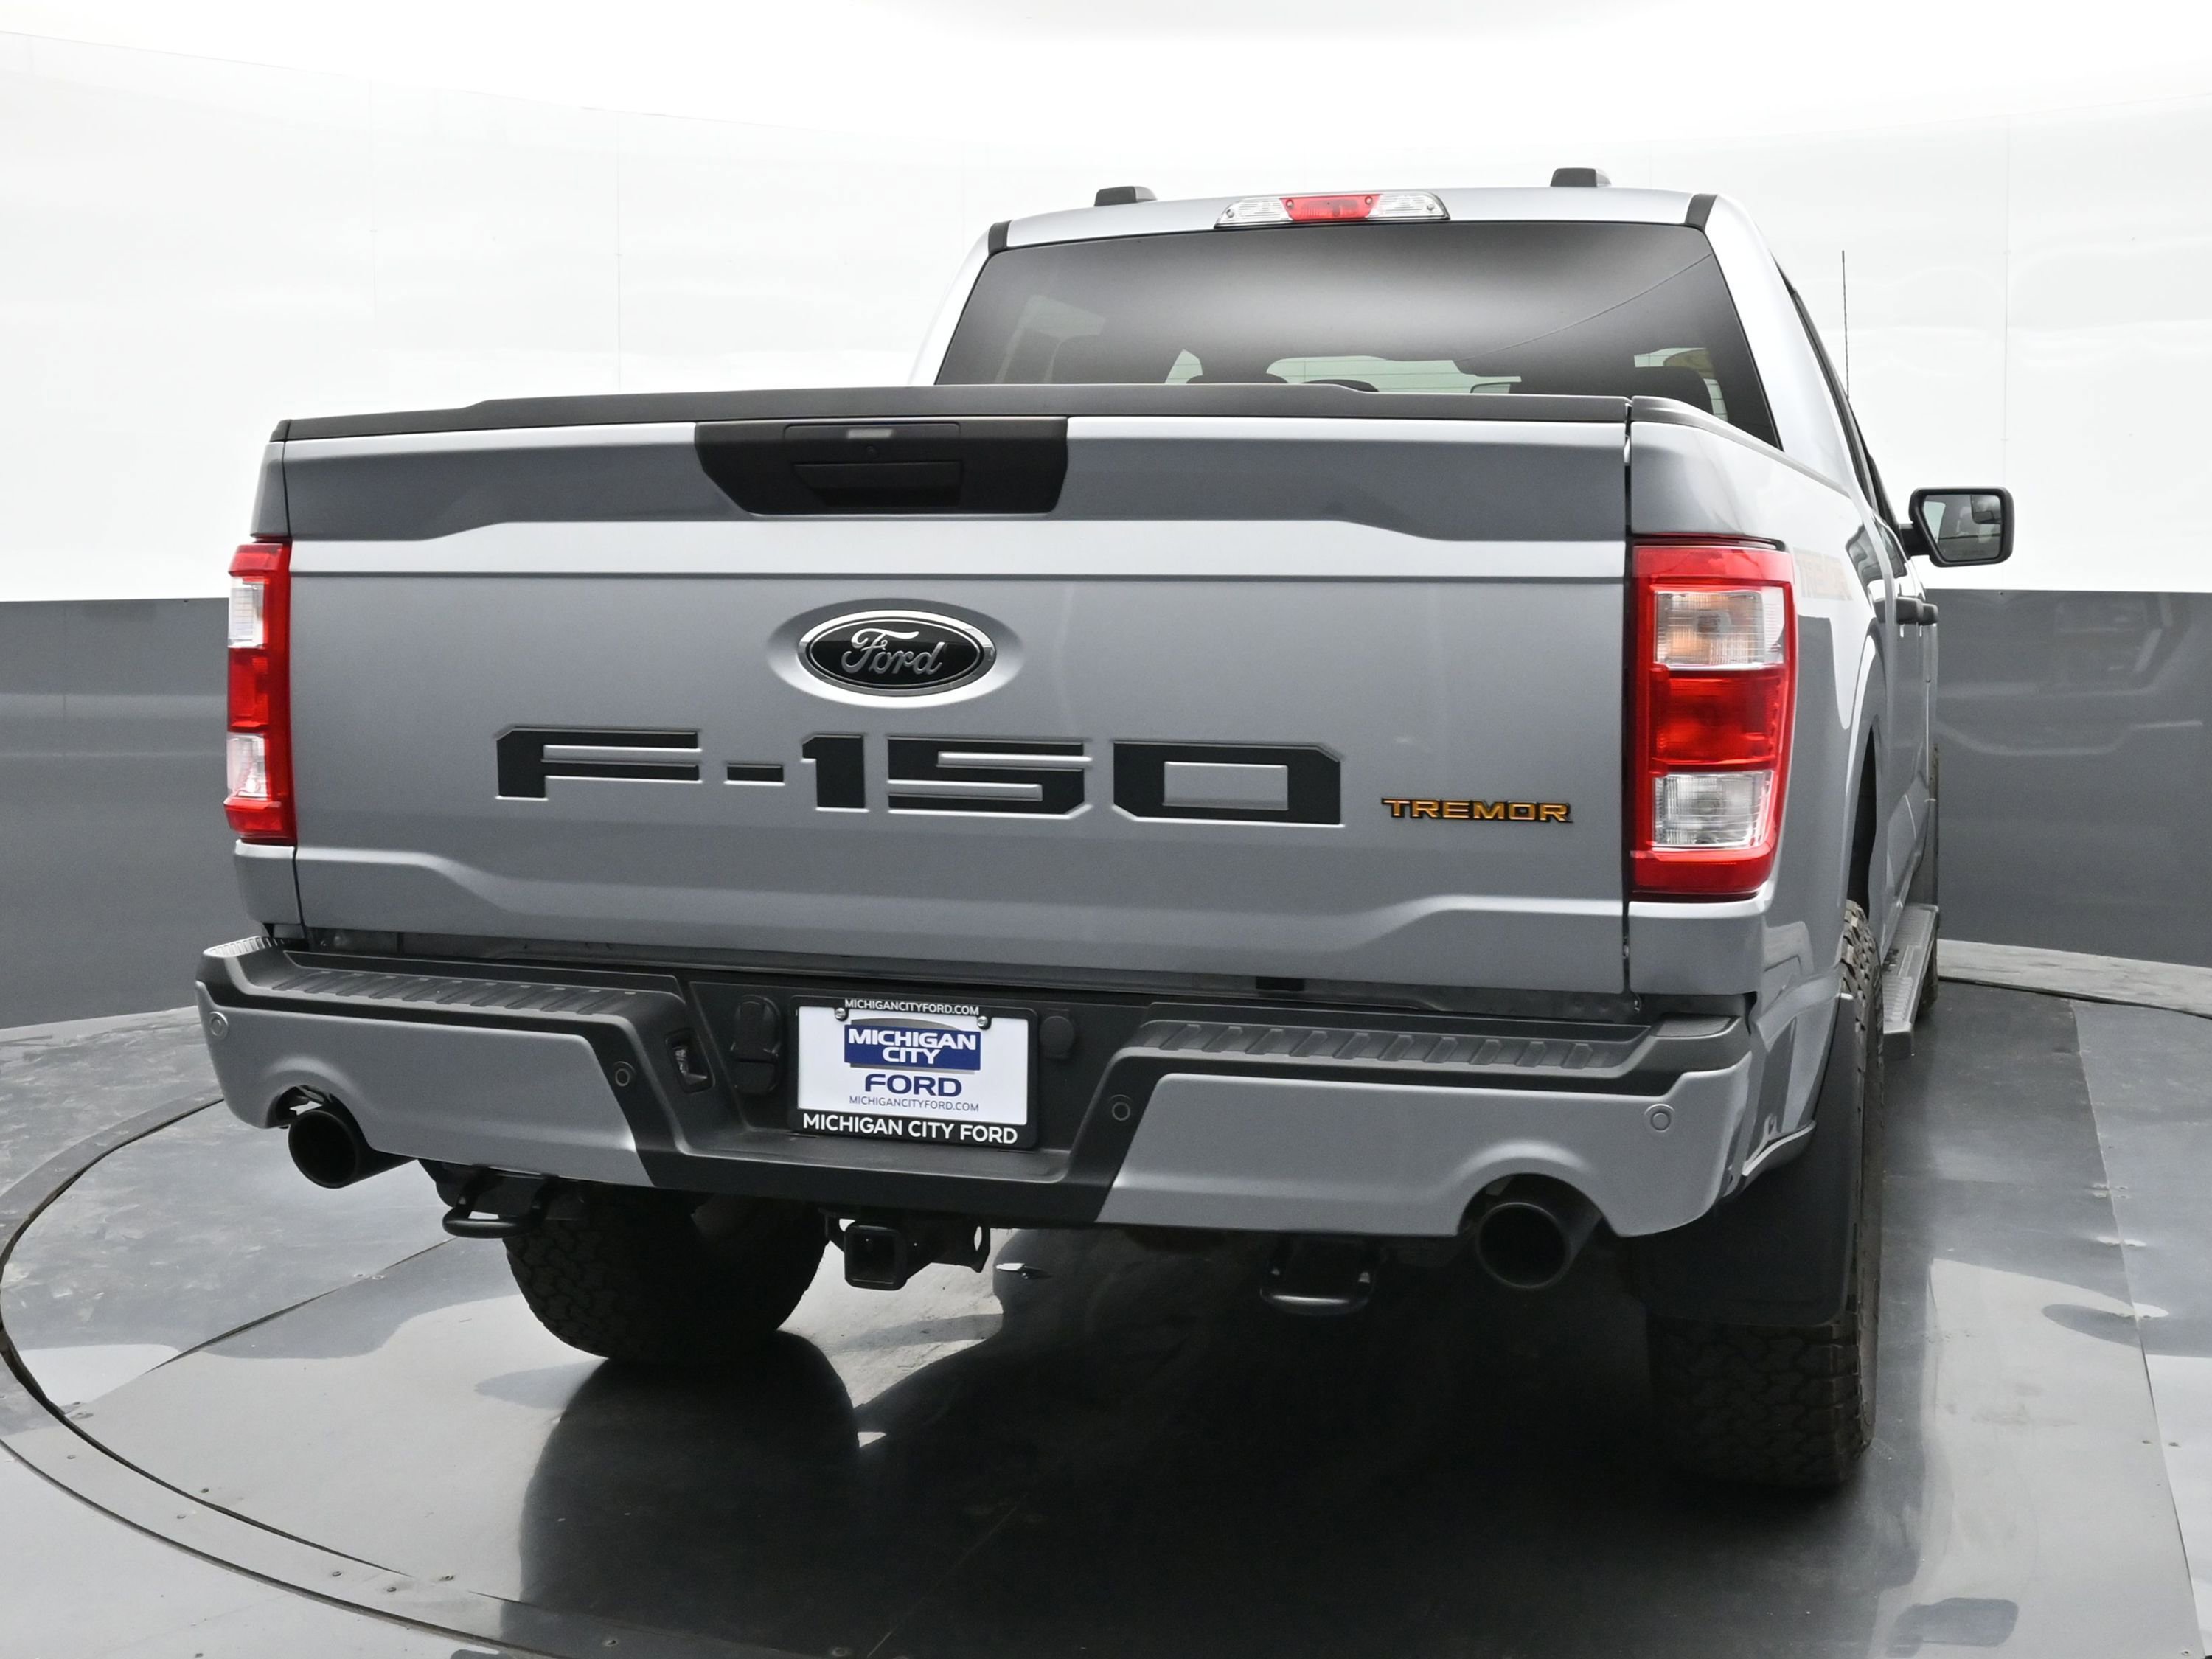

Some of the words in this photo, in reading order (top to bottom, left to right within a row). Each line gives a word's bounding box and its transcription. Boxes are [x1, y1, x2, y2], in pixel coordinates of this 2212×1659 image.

[841, 627, 945, 675] Ford
[495, 726, 1345, 827] F-150
[1381, 798, 1573, 823] TREMOR
[844, 998, 979, 1016] MICHIGANCITYFORD.COM
[848, 1029, 976, 1051] MICHIGAN
[883, 1046, 941, 1064] CITY
[864, 1074, 962, 1097] FORD
[849, 1096, 979, 1112] MICHIGANCITYFORD.COM
[803, 1113, 902, 1136] MICHIGAN
[908, 1120, 954, 1139] CITY
[960, 1124, 1018, 1144] FORD
